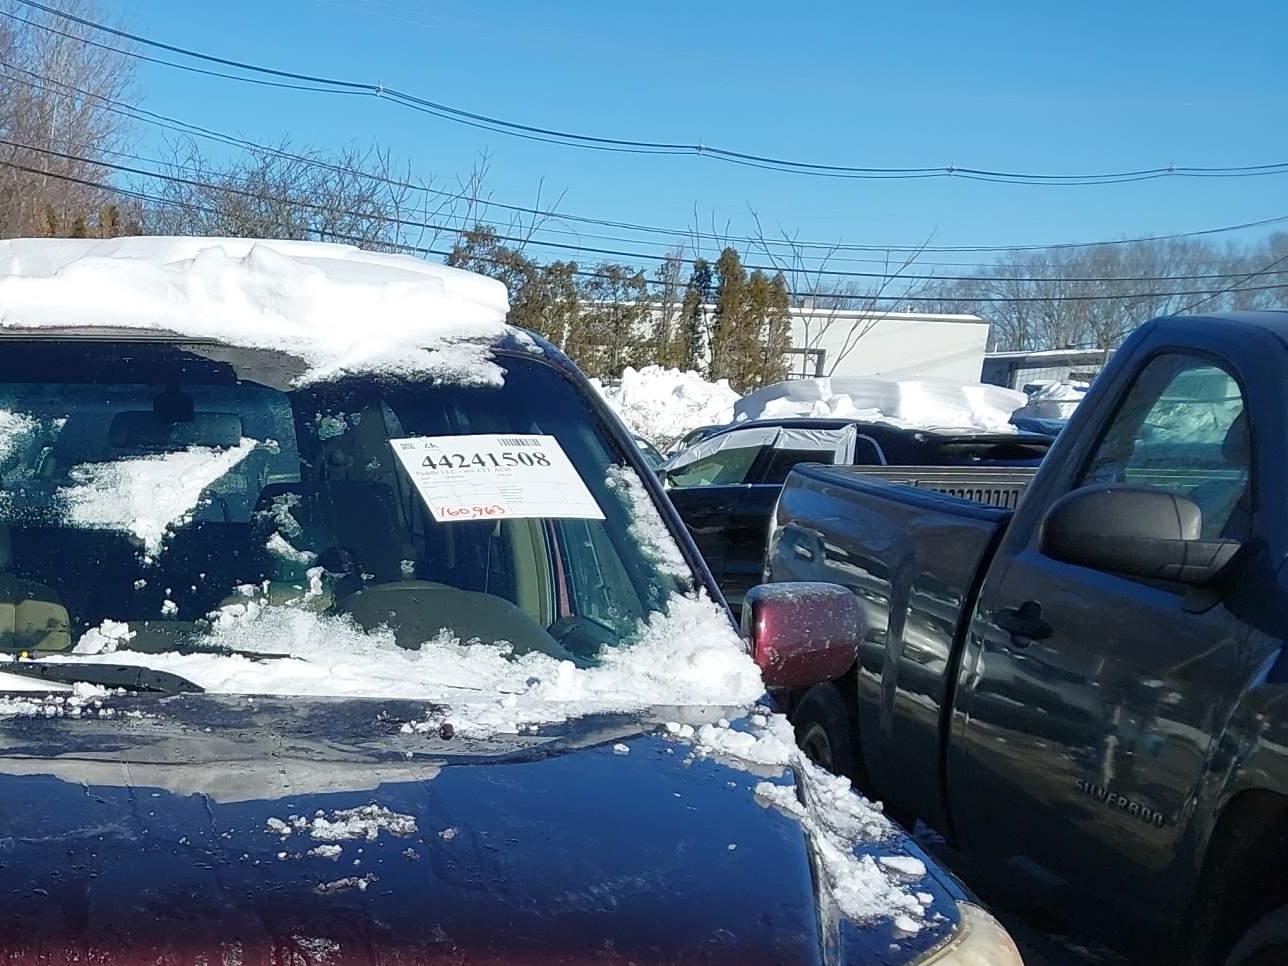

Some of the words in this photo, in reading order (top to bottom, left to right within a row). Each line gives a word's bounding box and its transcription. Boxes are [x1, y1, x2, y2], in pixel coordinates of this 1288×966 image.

[422, 451, 552, 470] 44241508
[441, 504, 506, 519] 160,963
[1075, 779, 1165, 827] SILVERADO
